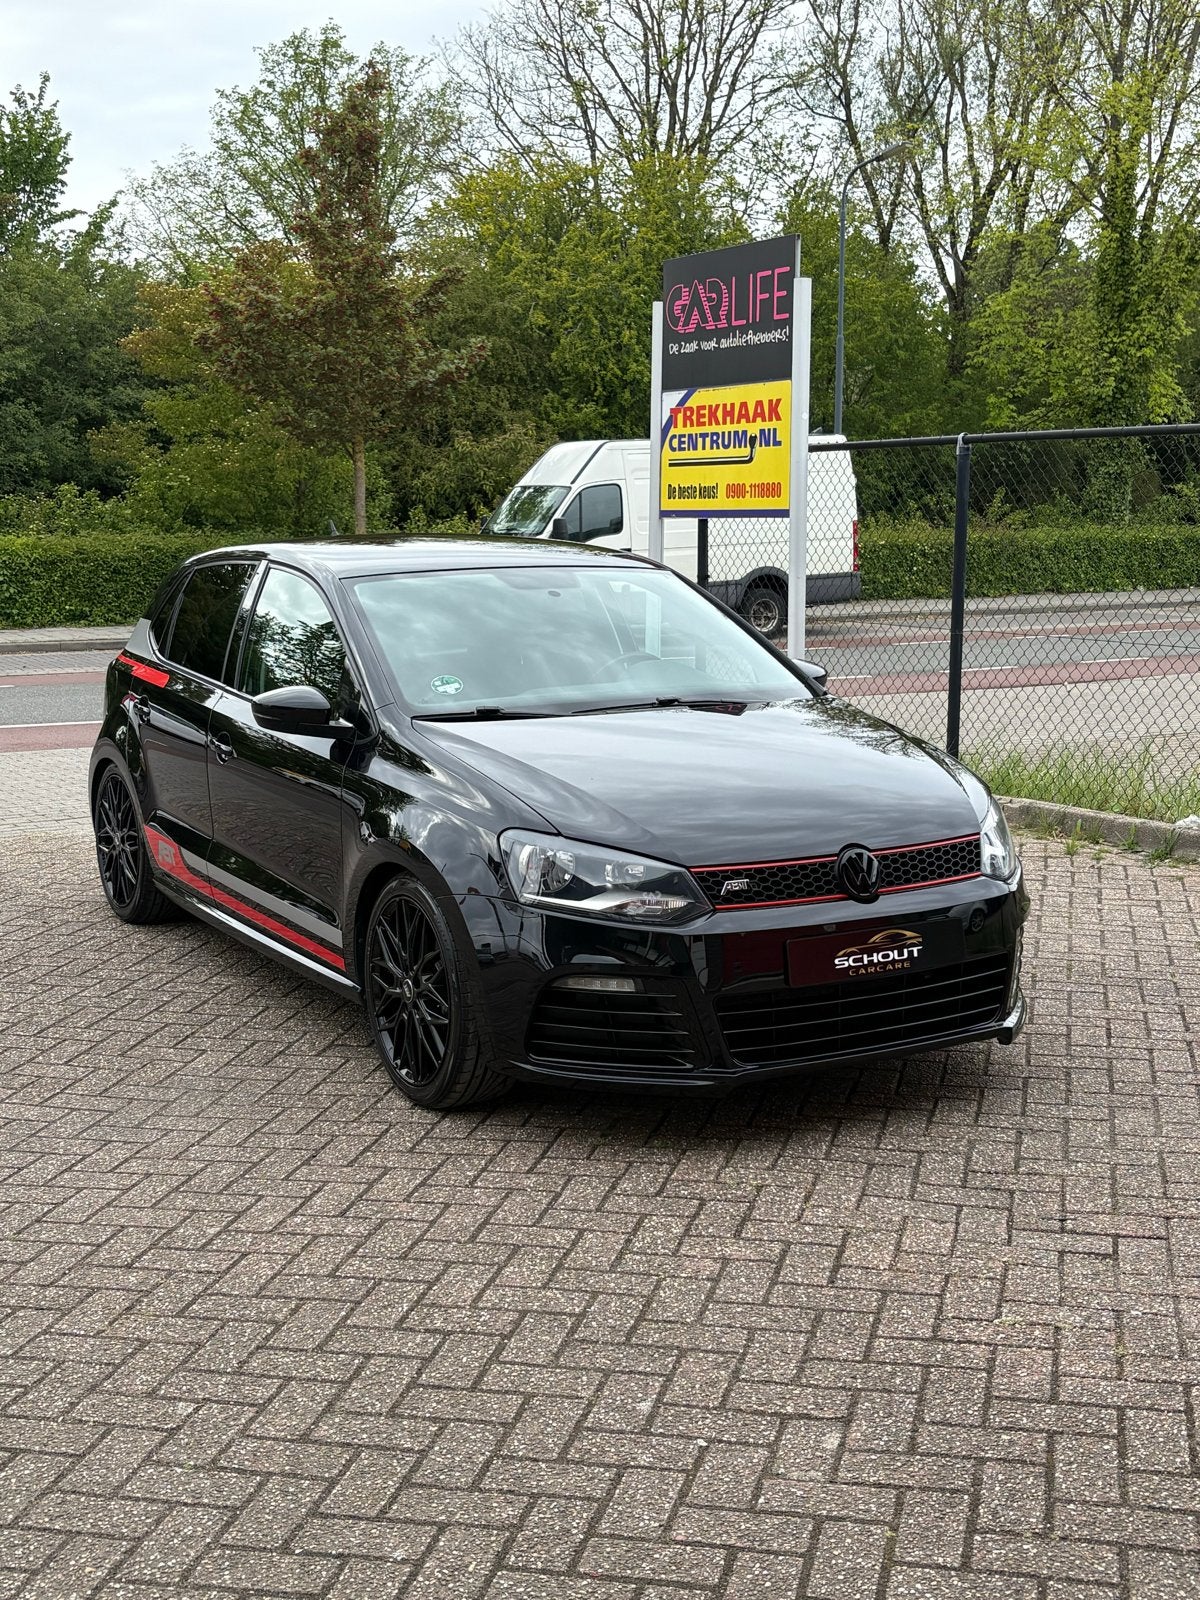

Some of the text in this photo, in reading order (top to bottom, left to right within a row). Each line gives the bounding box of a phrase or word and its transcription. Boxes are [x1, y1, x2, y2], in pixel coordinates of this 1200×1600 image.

[668, 343, 679, 355] De
[669, 398, 782, 428] TREKHAAK
[667, 482, 782, 500] De beste keus! 0900-1118880
[834, 945, 923, 969] SCHOUT
[848, 960, 912, 976] CARCARE
